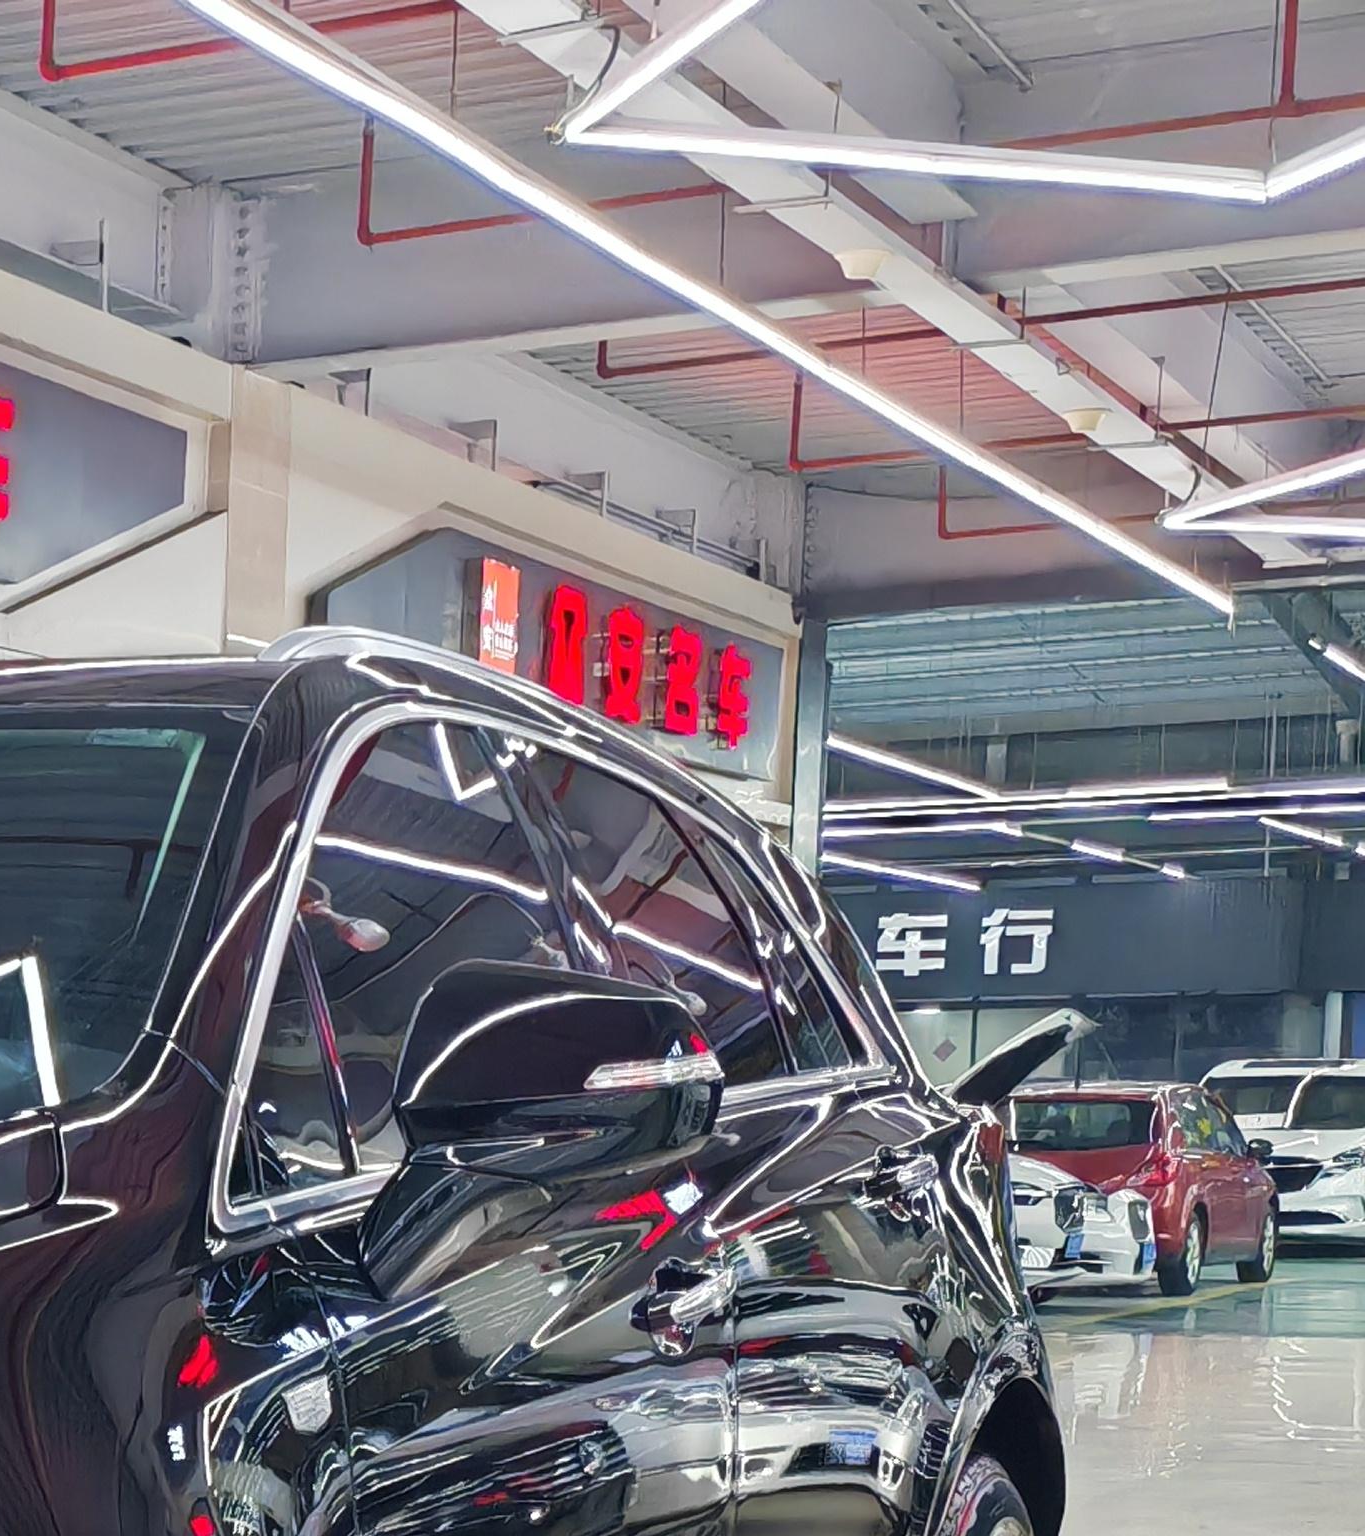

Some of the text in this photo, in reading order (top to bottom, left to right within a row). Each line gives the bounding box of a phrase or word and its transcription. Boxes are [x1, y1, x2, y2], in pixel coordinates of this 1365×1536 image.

[548, 583, 751, 750] 众安名车
[874, 907, 1055, 978] 车行
